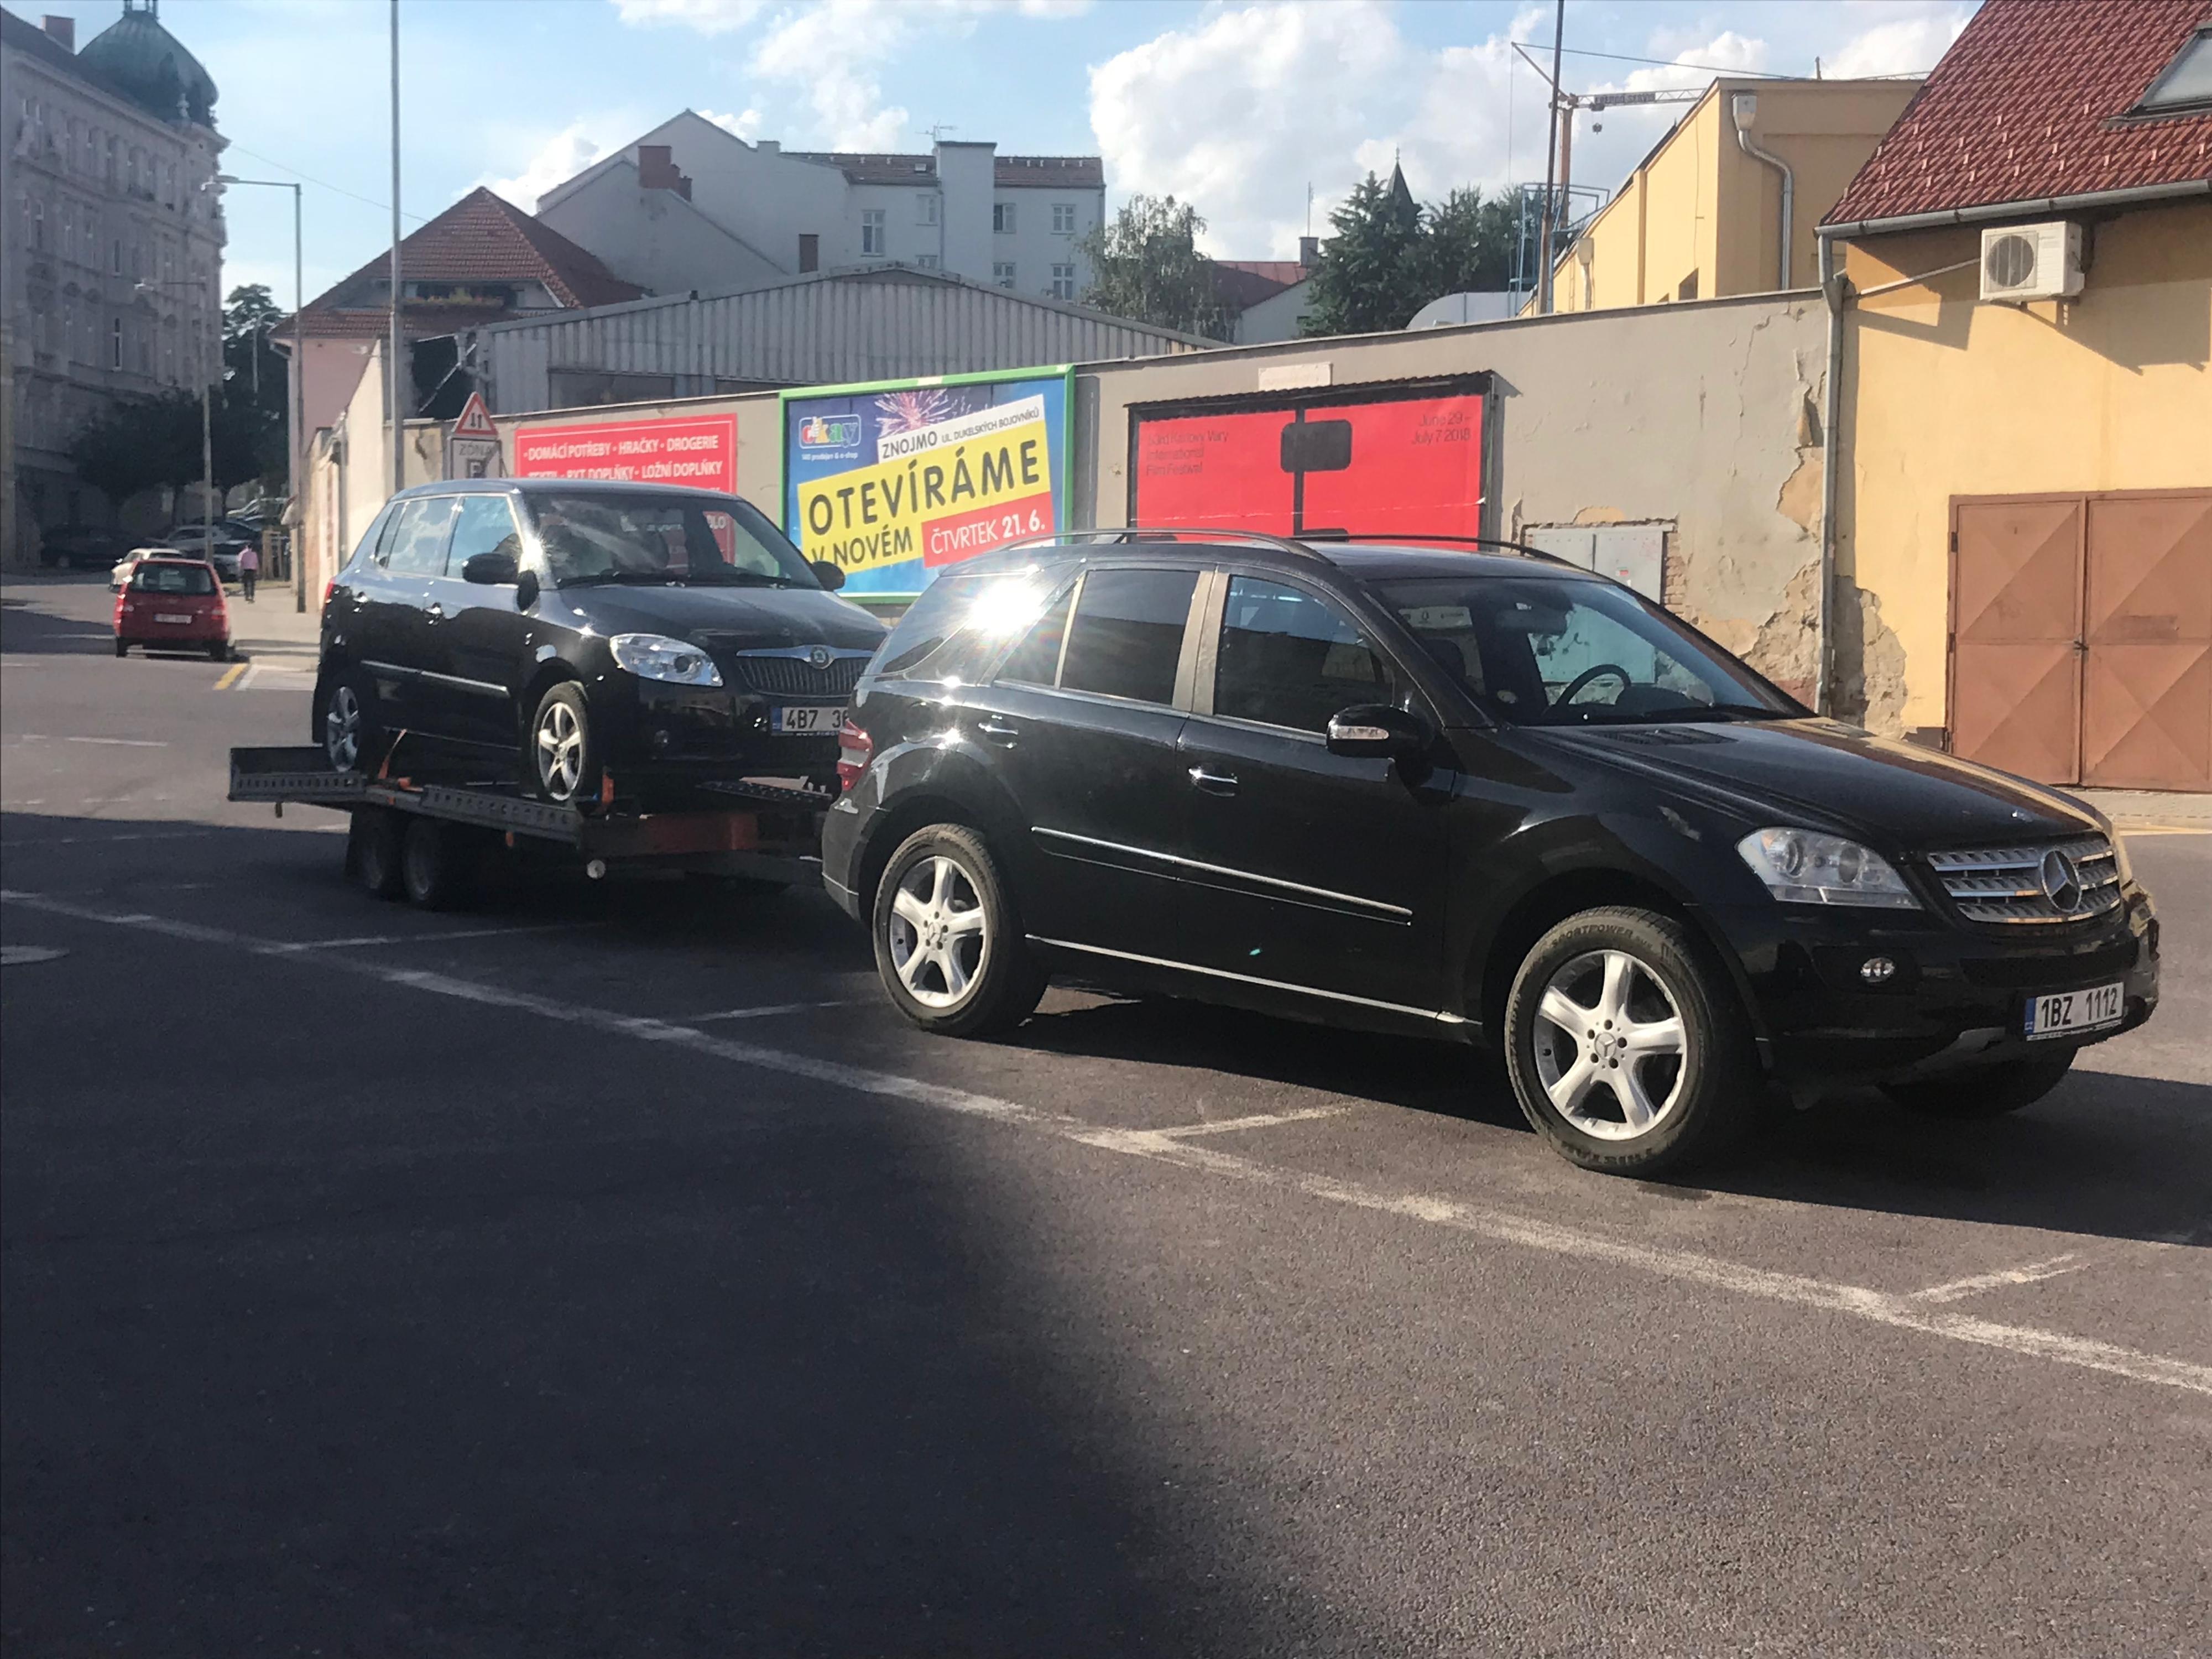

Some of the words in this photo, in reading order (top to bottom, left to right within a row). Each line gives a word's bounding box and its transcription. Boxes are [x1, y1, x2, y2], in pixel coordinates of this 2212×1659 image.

[881, 430, 938, 459] ZNOJMO
[954, 420, 998, 440] DUKELSKÝCH
[999, 407, 1040, 428] BOJOVNÍKŮ
[1447, 411, 1463, 425] 29
[528, 442, 567, 461] DOMÁCÍ
[568, 440, 611, 458] POTŘEBY
[618, 436, 659, 455] HRAČKY
[666, 435, 719, 452] DROGERIE
[1444, 427, 1471, 442] 2018
[641, 460, 672, 479] LOŽNÍ
[673, 458, 723, 478] DOPLŇKY
[808, 439, 1040, 536] OTEVÍRÁME
[833, 523, 913, 567] NOVÉM
[931, 518, 998, 554] ČTVRTEK
[786, 709, 818, 729] 4B7
[2041, 995, 2074, 1028] 1BZ
[2085, 987, 2117, 1021] 1112
